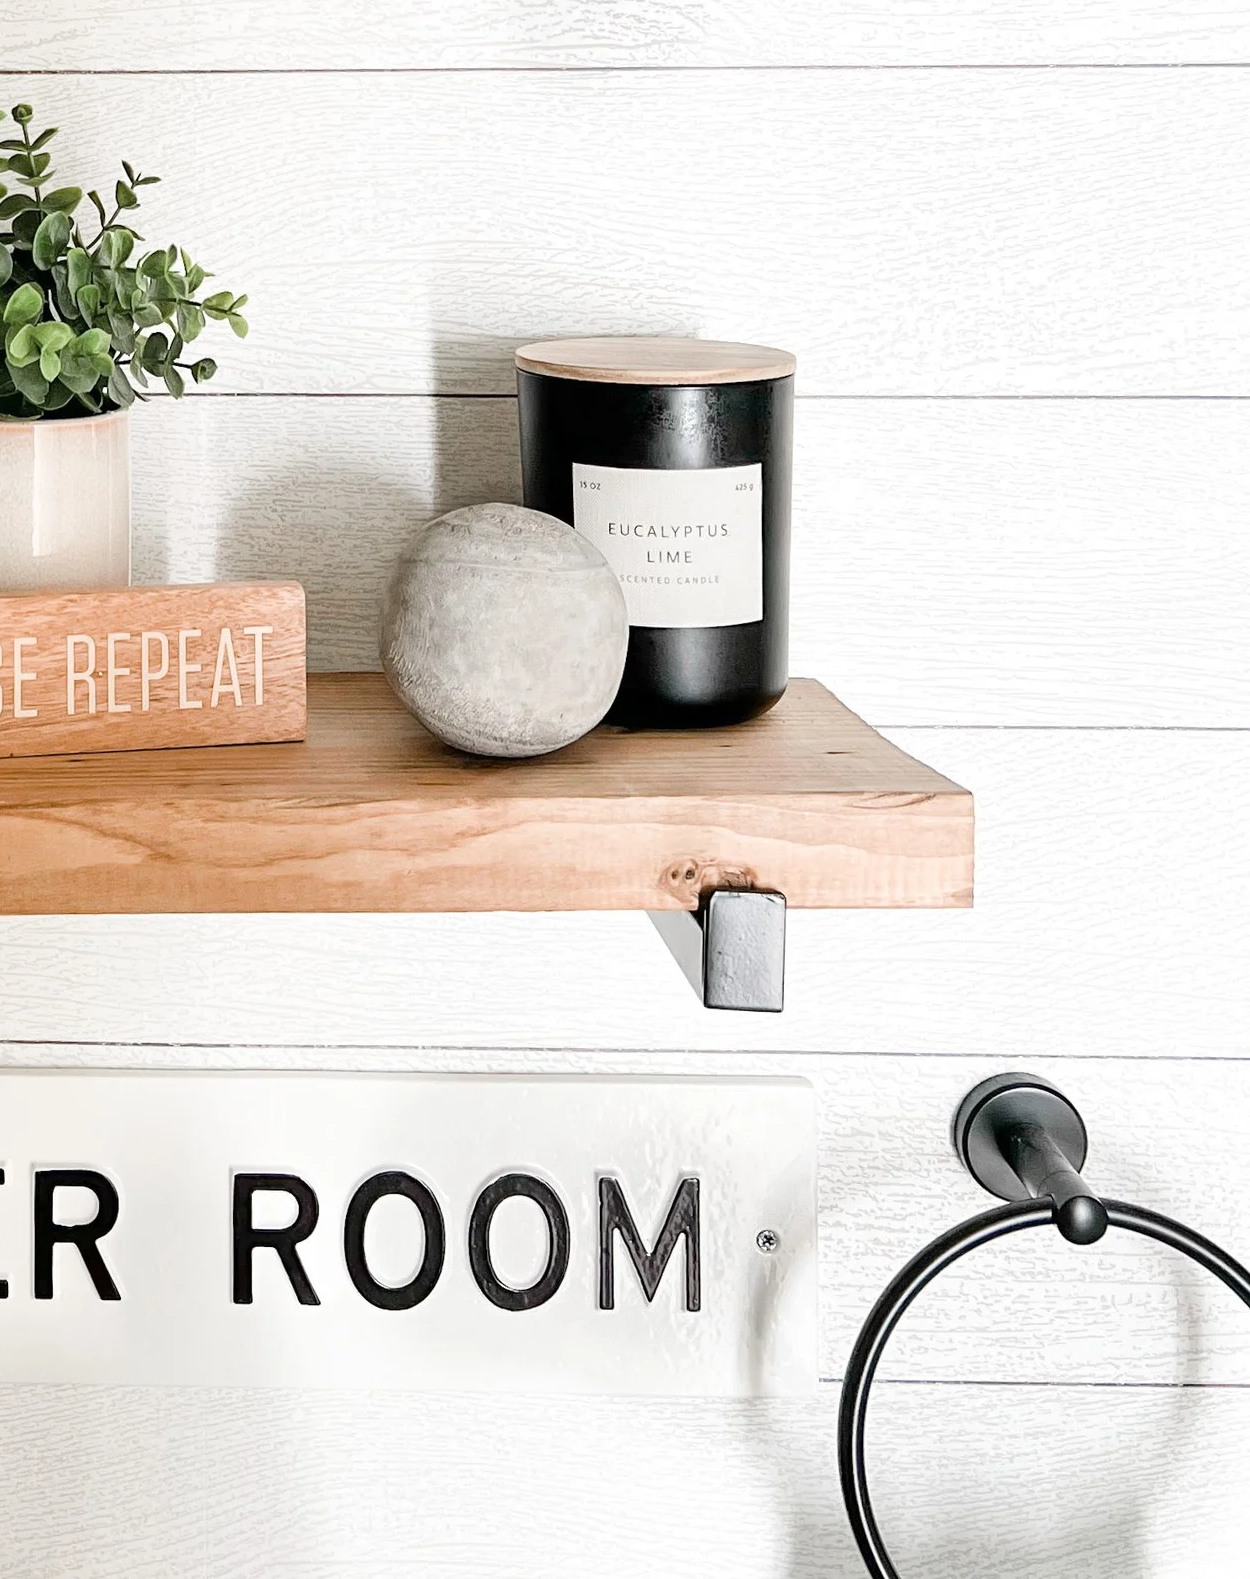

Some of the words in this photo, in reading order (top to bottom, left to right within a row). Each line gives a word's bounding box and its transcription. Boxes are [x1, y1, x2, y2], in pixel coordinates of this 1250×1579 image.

[608, 522, 728, 538] EUCALYPTUS
[647, 550, 692, 564] LIME
[619, 574, 671, 585] SCENTED
[676, 575, 720, 585] CANDLE
[66, 625, 273, 716] REPEAT
[232, 1170, 701, 1313] ROOM
